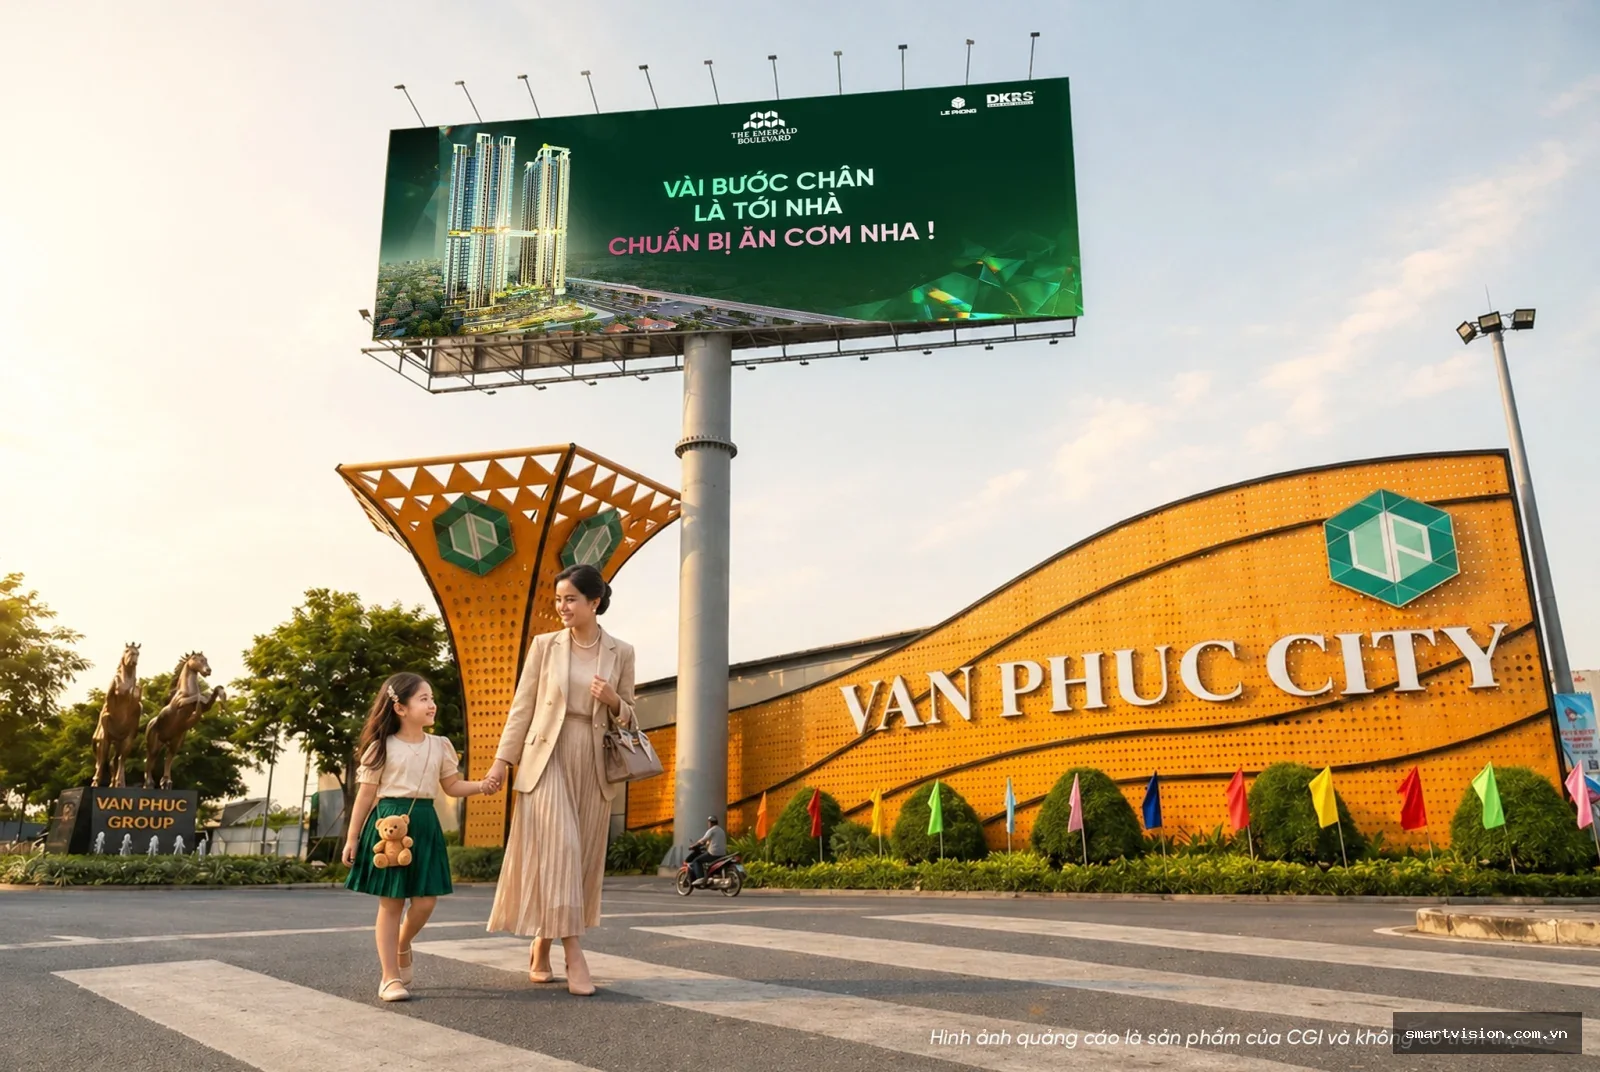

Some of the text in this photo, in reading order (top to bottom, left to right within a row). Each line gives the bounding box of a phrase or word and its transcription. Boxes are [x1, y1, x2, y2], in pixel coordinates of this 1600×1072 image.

[986, 91, 1034, 104] DKRS
[731, 127, 798, 139] THE EMERALD
[737, 134, 792, 145] BOULEVARD
[663, 164, 874, 198] VÀI BƯỚC CHÂN
[694, 191, 843, 222] LÀ TỚI NHÀ
[608, 220, 935, 256] CHUẨN BỊ ĂN CƠM NHA !
[840, 622, 1509, 735] VAN PHUC CITY
[96, 797, 188, 812] VAN PHUC
[107, 815, 175, 829] GROUP
